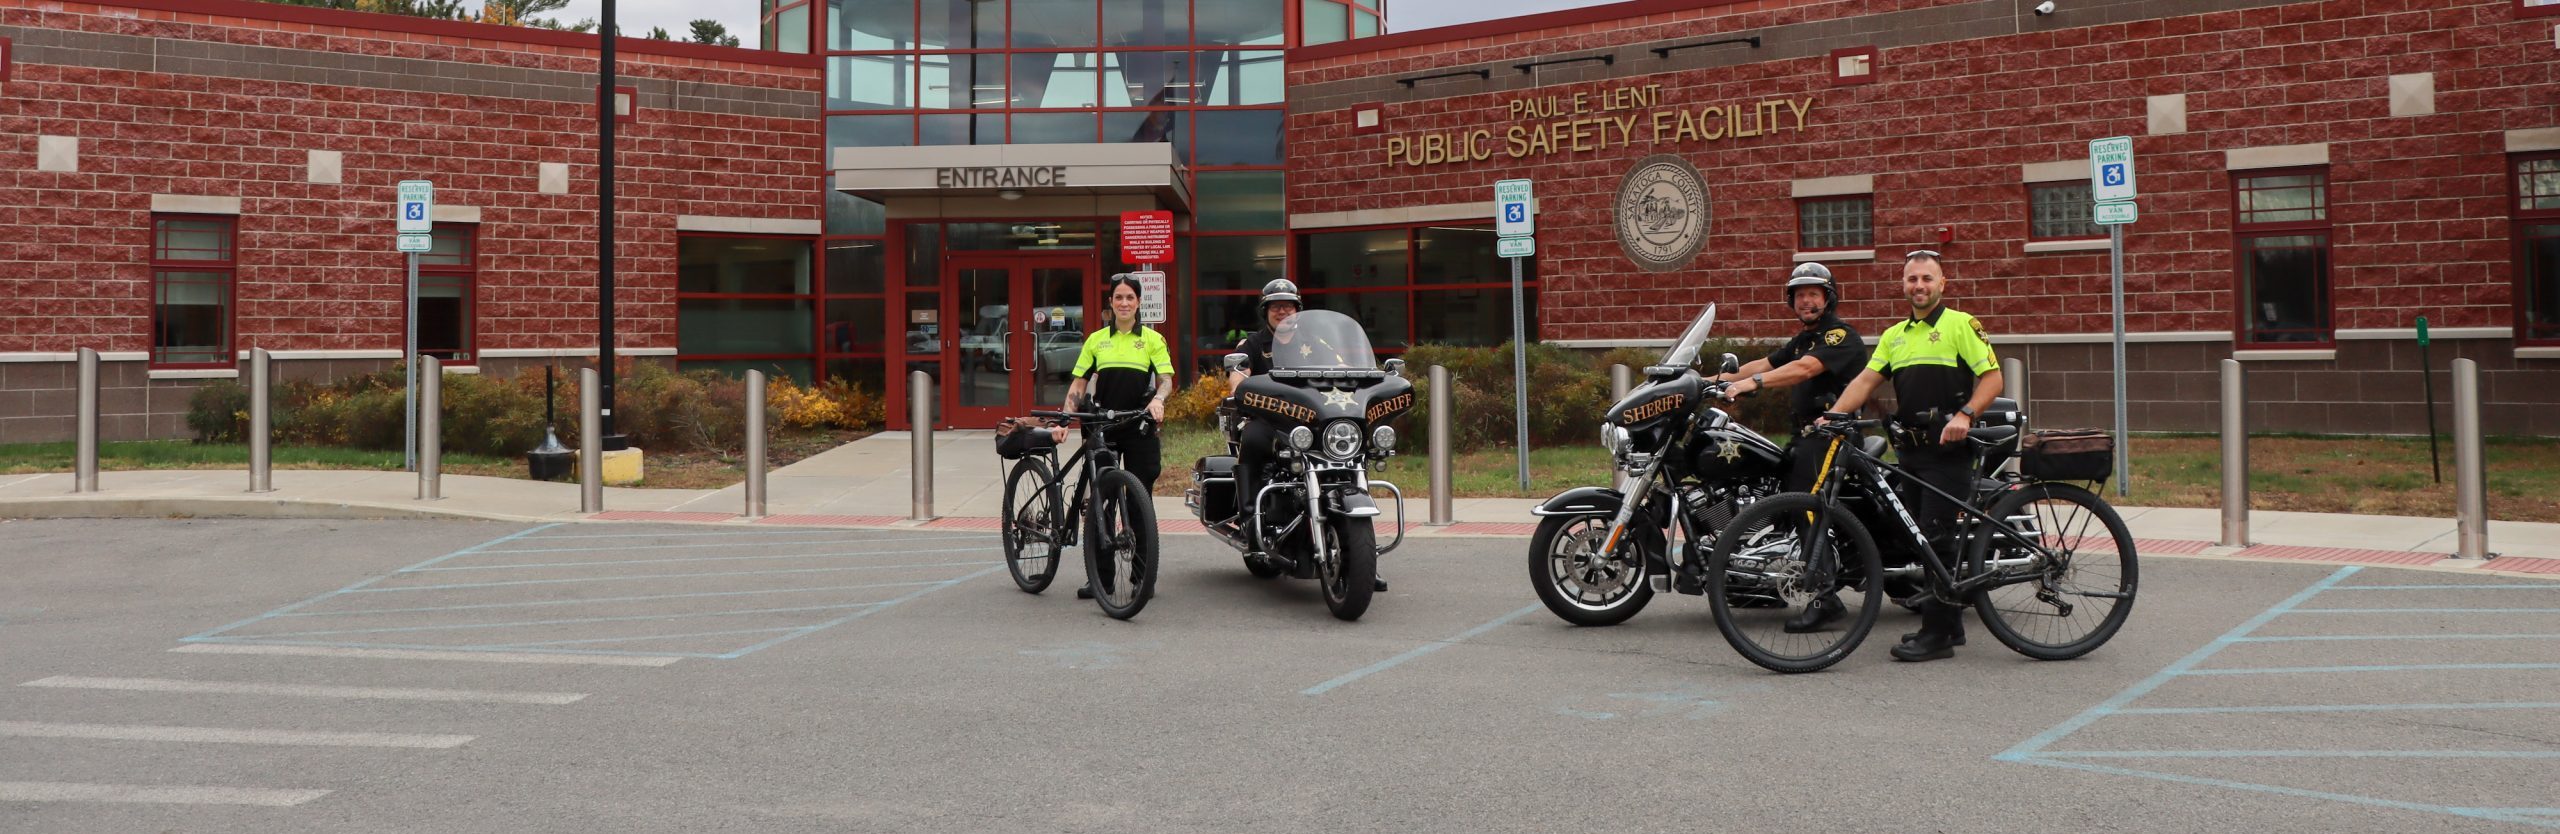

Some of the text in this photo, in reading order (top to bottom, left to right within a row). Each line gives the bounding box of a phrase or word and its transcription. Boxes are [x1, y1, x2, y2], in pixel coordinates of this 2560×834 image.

[1510, 96, 1565, 120] PAUL
[1603, 84, 1661, 111] LENT
[1387, 97, 1813, 168] PUBLIC SAFETY FACILITY
[2094, 142, 2128, 154] RESERVED
[2097, 152, 2127, 163] PARKING
[936, 166, 1067, 188] ENTRANCE
[401, 185, 429, 193] RESERVED
[403, 193, 427, 201] PARKING
[1499, 184, 1528, 193] RESERVED
[1502, 193, 1527, 202] PARKING
[1628, 171, 1697, 220] SARATOGA COUNTY
[1653, 245, 1673, 255] 1791
[1243, 392, 1317, 423] SHERIFF
[1367, 393, 1412, 424] SHERIFF
[1623, 394, 1684, 425] SHERIFF
[1876, 472, 1929, 546] TREK
